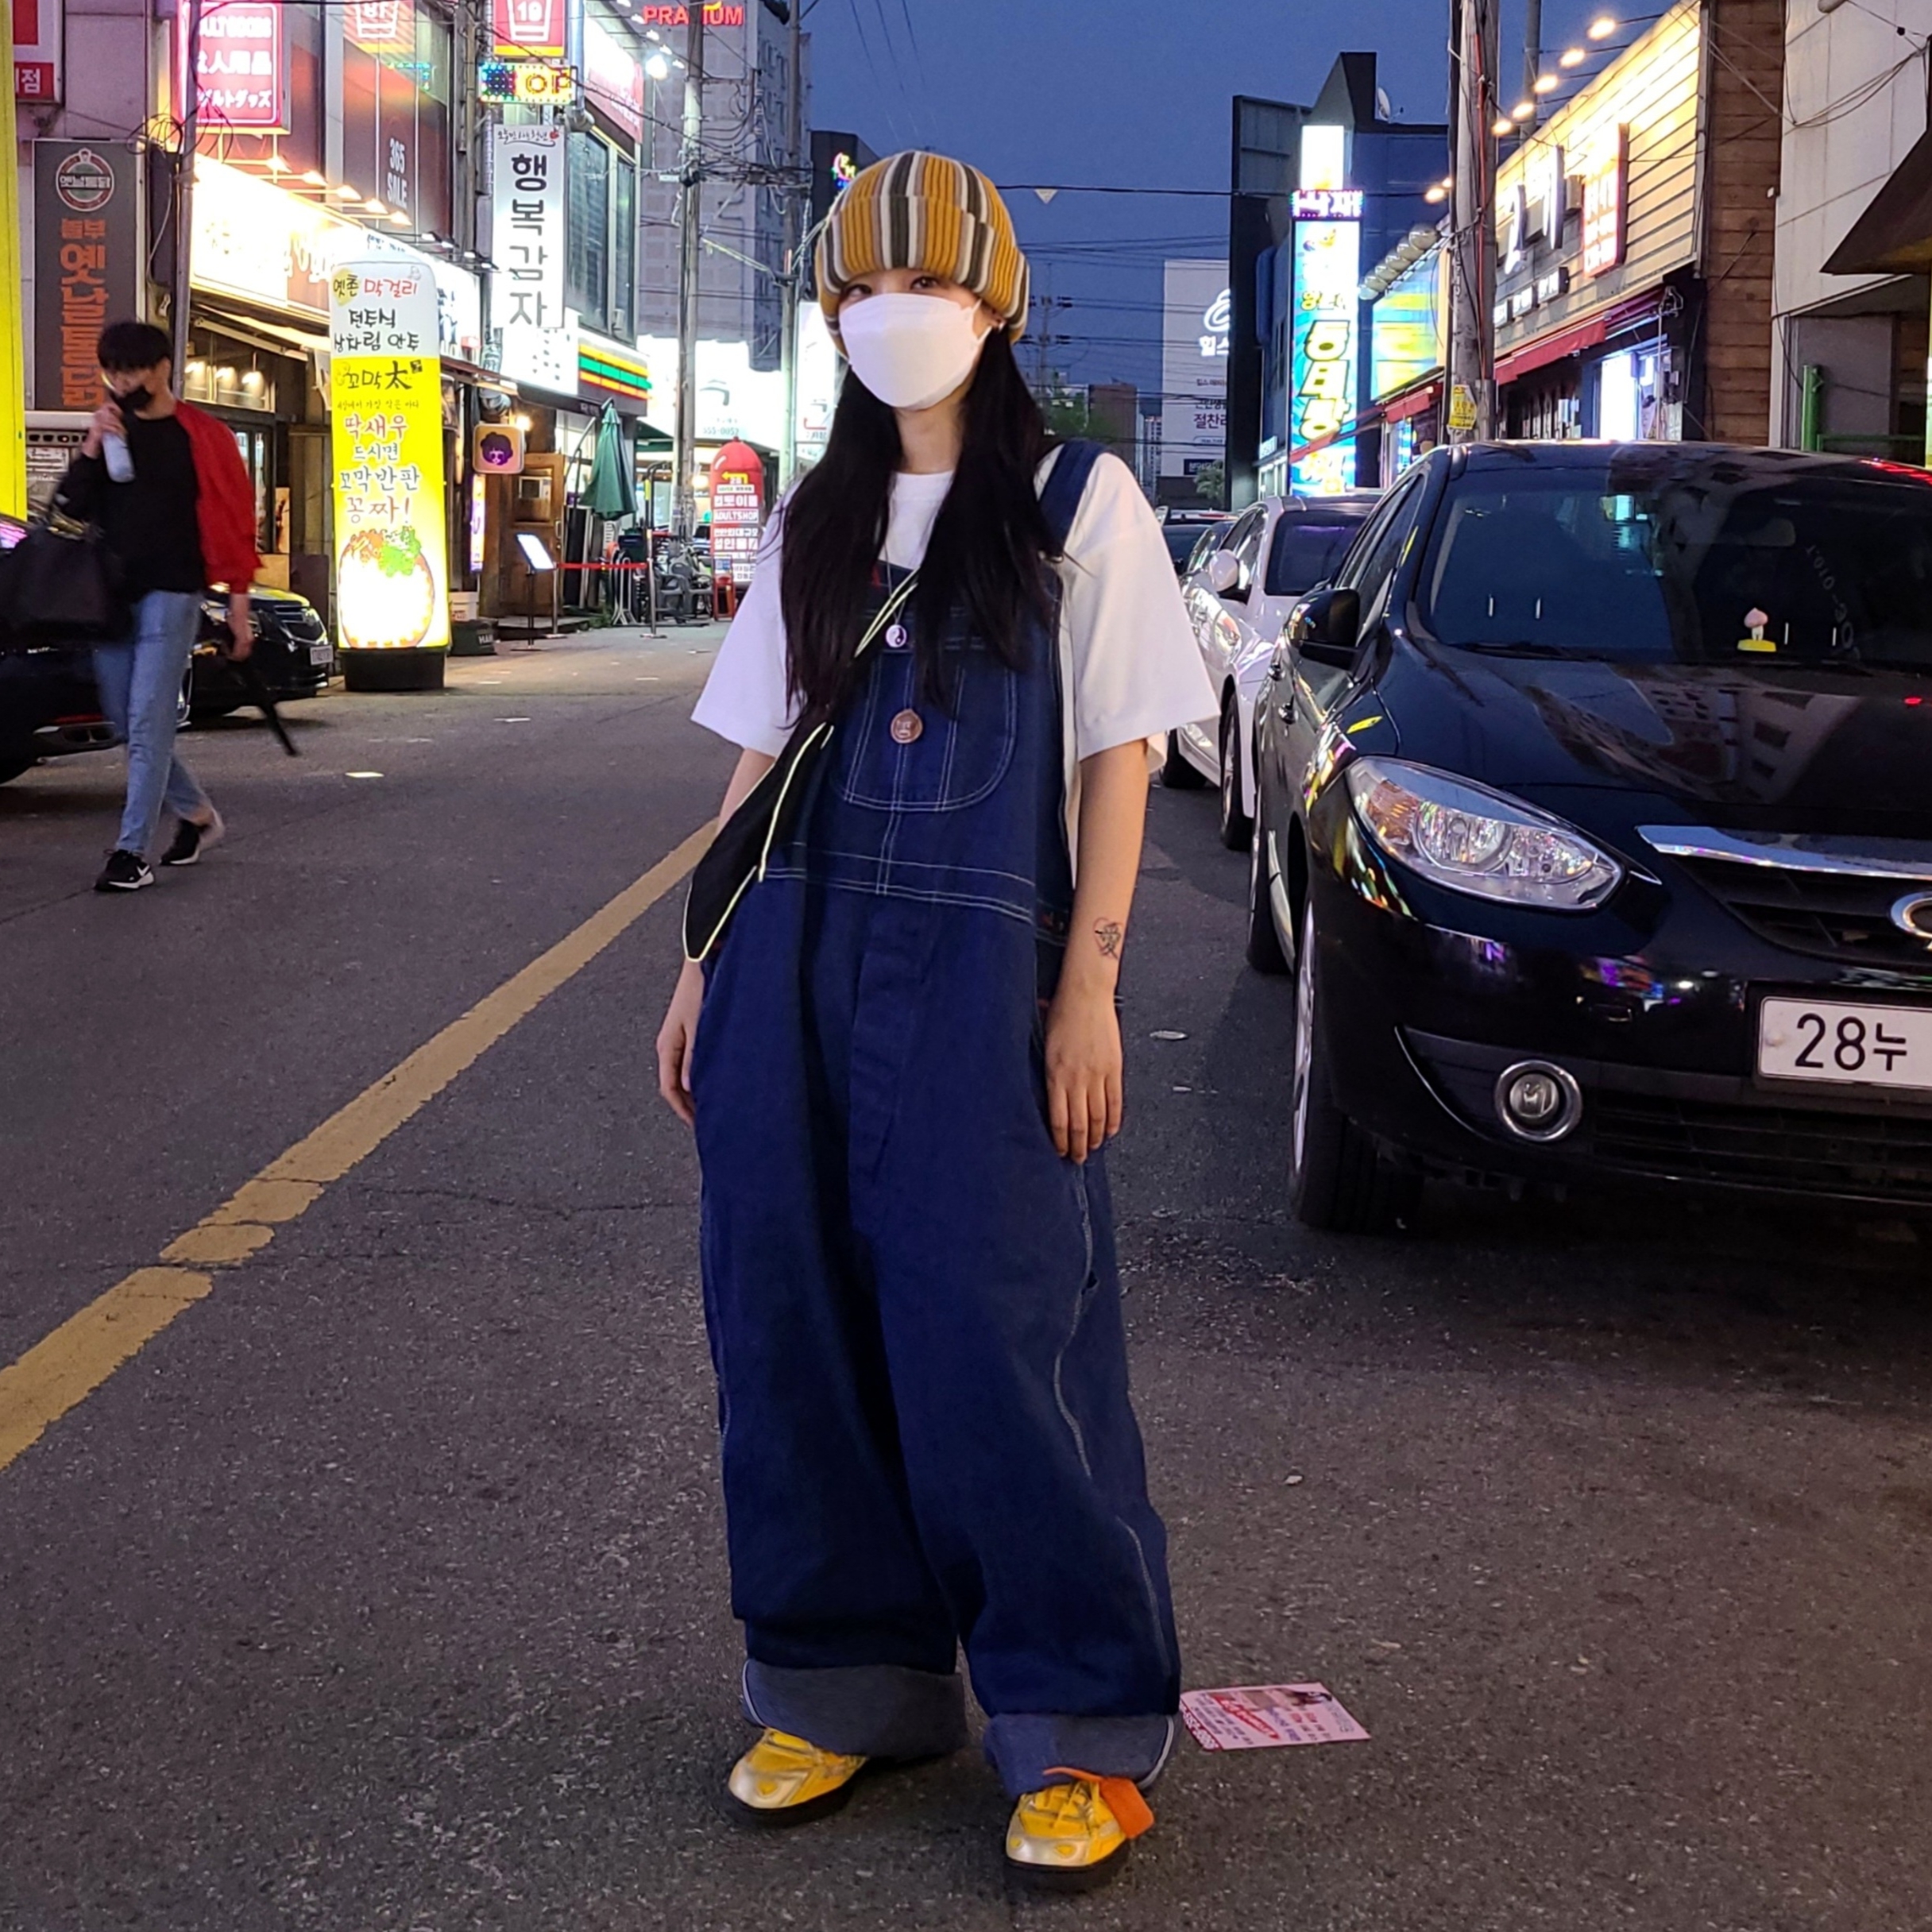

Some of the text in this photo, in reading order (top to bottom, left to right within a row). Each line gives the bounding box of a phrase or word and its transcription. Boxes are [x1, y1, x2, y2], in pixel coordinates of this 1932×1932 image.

[643, 5, 744, 25] PRAIUM
[16, 68, 41, 94] 점
[389, 137, 405, 174] 365
[509, 153, 548, 327] 행복감자
[333, 274, 418, 298] 옛촌 막걸리
[345, 414, 408, 438] 딱새우
[354, 443, 398, 460] 드시면
[346, 496, 411, 524] 꽁짜!
[1795, 1013, 1907, 1072] 28누
